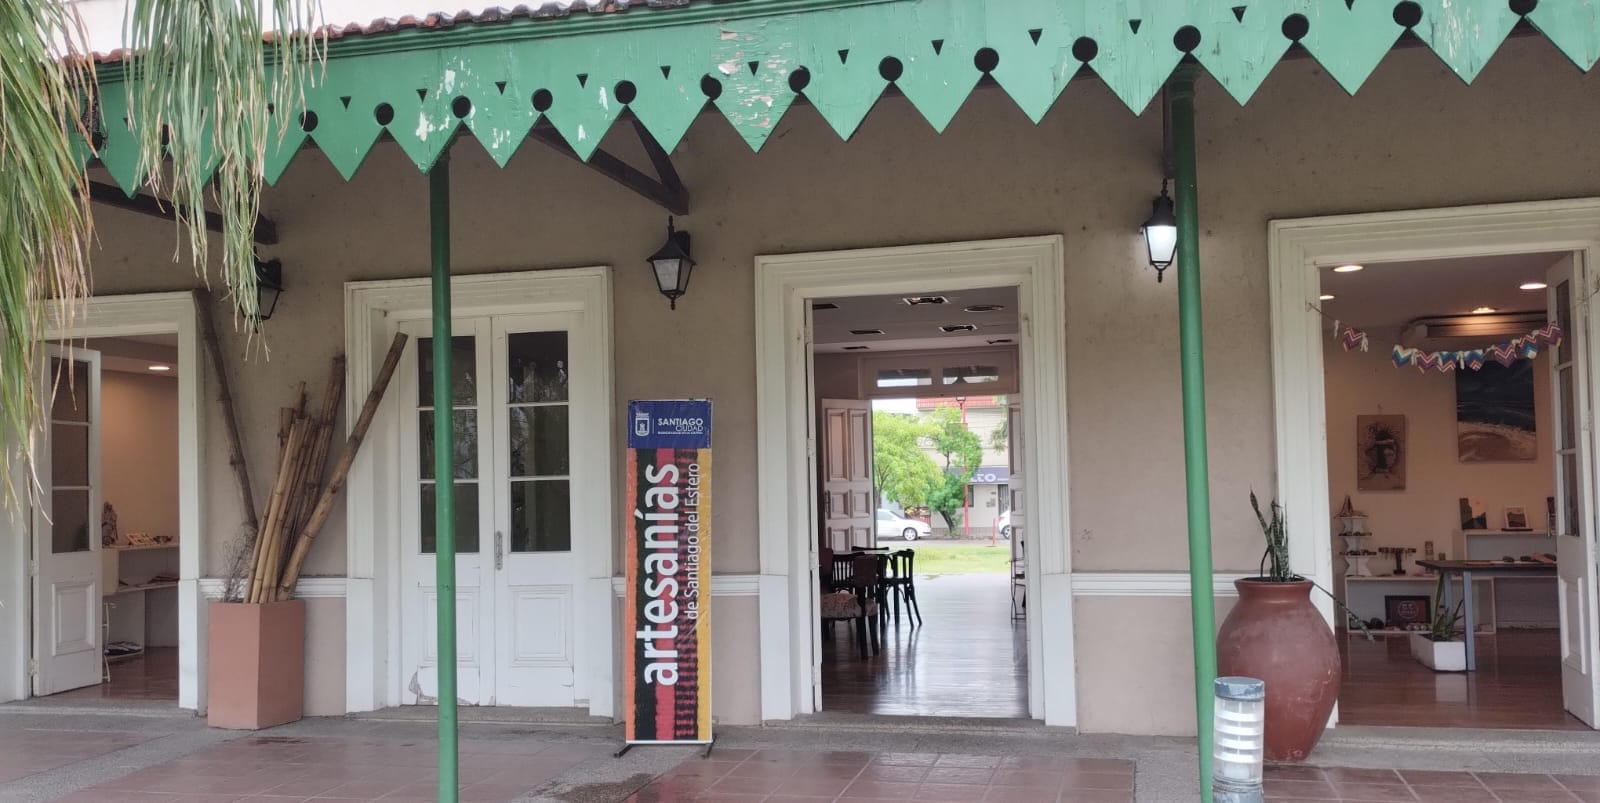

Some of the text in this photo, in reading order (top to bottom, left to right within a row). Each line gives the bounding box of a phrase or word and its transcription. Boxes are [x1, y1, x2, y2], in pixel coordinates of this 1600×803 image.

[657, 418, 704, 426] SANTIAGO
[634, 463, 680, 686] artesanías
[684, 463, 702, 620] de Santiago del Estero
